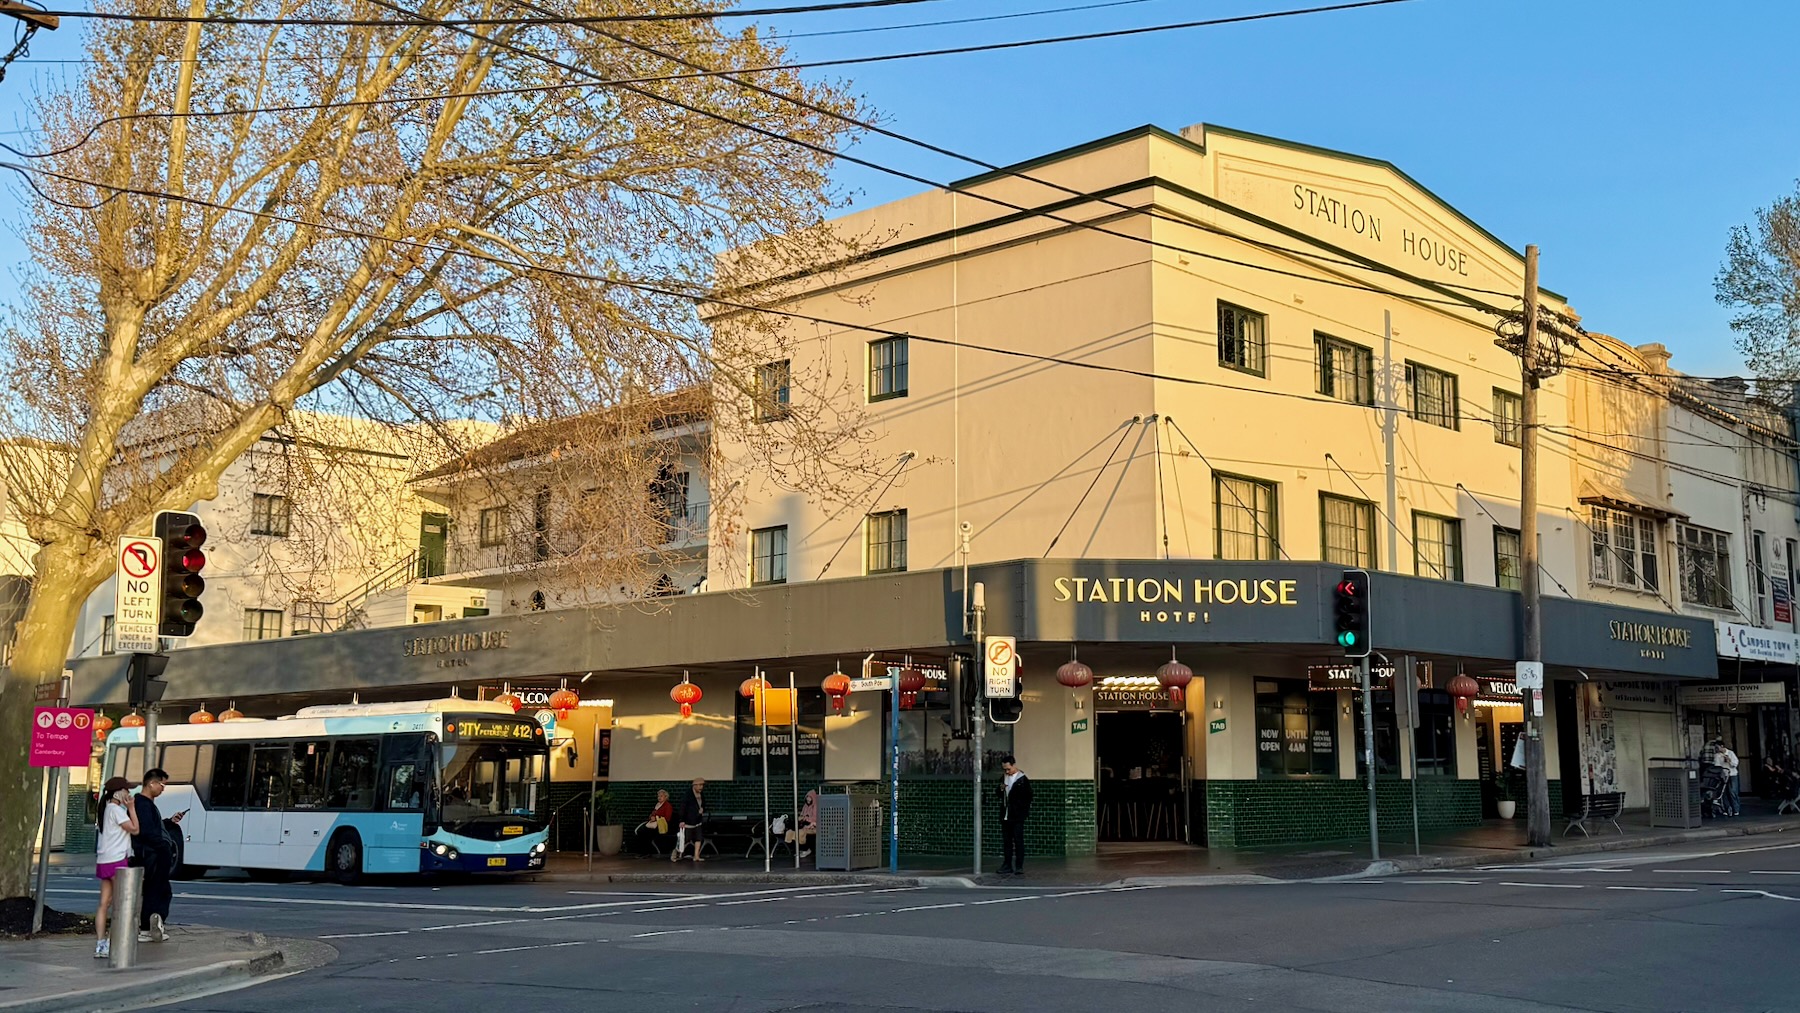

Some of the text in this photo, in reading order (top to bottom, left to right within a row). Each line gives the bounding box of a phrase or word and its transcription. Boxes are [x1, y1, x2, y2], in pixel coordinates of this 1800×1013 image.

[1294, 184, 1468, 276] STATION HOUSE
[127, 580, 149, 593] NO
[1053, 577, 1298, 604] STATION HOUSE
[124, 597, 151, 606] LEFT
[122, 609, 153, 619] TURN
[120, 625, 153, 633] VEHICLES
[118, 641, 153, 650] EXCEPTED
[993, 667, 1007, 676] NO
[1098, 692, 1168, 701] STATION HOUSE
[459, 722, 481, 736] CITY
[513, 725, 531, 738] 412
[1072, 722, 1087, 730] TAB
[1211, 722, 1226, 730] TAB
[1261, 729, 1279, 738] NOW
[1285, 730, 1308, 739] UNTIL
[742, 736, 761, 744] NOW
[768, 735, 792, 744] UNTIL
[741, 747, 761, 755] OPEN
[770, 747, 789, 755] 4AM
[1260, 742, 1280, 751] OPEN
[1288, 743, 1306, 752] 4AM
